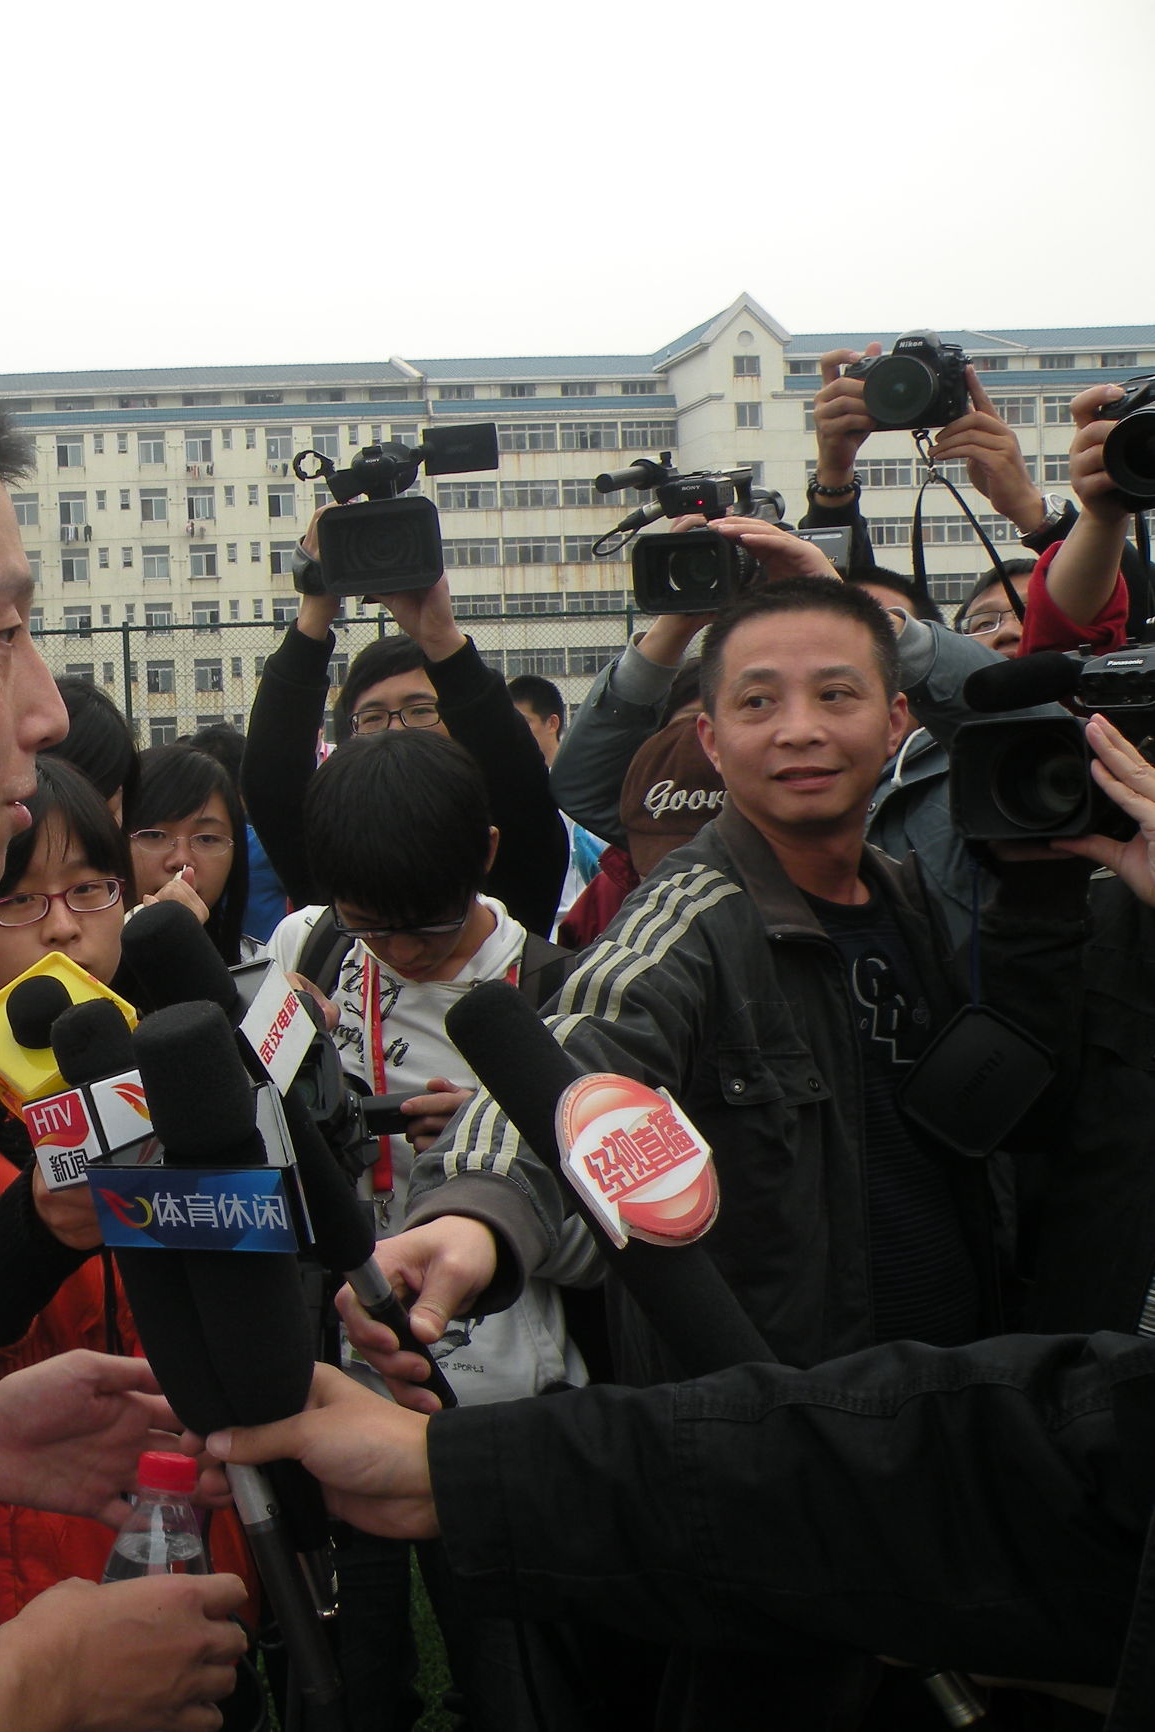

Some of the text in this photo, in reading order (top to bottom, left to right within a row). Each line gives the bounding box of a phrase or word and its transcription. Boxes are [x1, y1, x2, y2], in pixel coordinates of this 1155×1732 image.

[899, 340, 923, 348] Nikon
[259, 991, 300, 1065] 武汉电视
[30, 1100, 72, 1135] HTV
[48, 1148, 88, 1182] 新闻
[583, 1104, 701, 1203] 经视直播
[152, 1192, 288, 1230] 体育休闲
